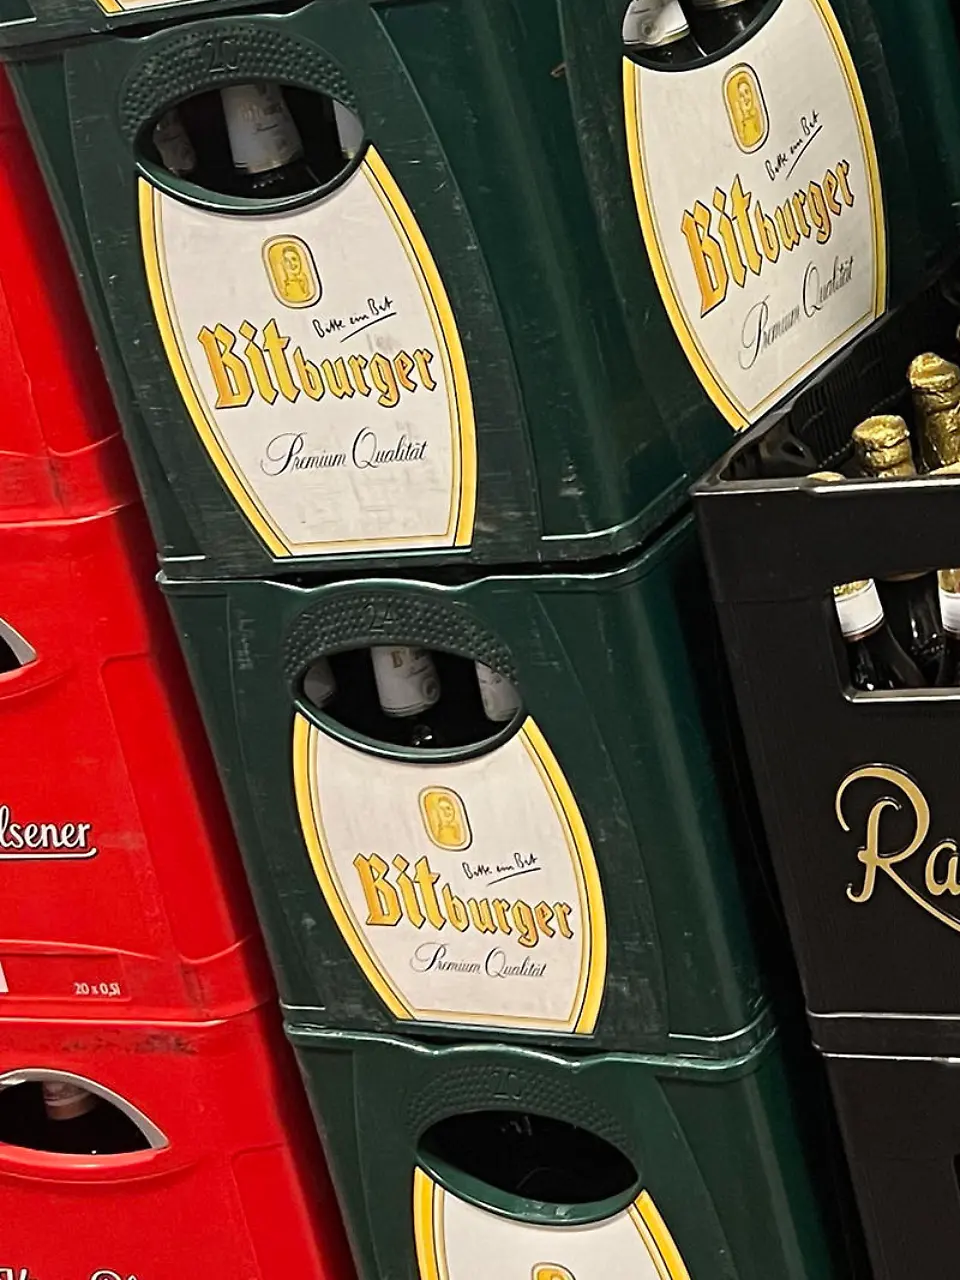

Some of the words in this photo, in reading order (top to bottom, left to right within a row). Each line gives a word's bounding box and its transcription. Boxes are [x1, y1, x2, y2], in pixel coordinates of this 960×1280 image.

[680, 157, 856, 320] Bitburger
[738, 293, 800, 372] Premium
[802, 254, 855, 313] Qualität
[197, 318, 437, 410] Bitburger
[260, 431, 347, 477] Premium
[351, 426, 429, 469] Qualität
[353, 851, 575, 949] Bitburger
[74, 982, 89, 996] 20
[410, 942, 482, 977] Premium
[484, 946, 547, 979] Qualität
